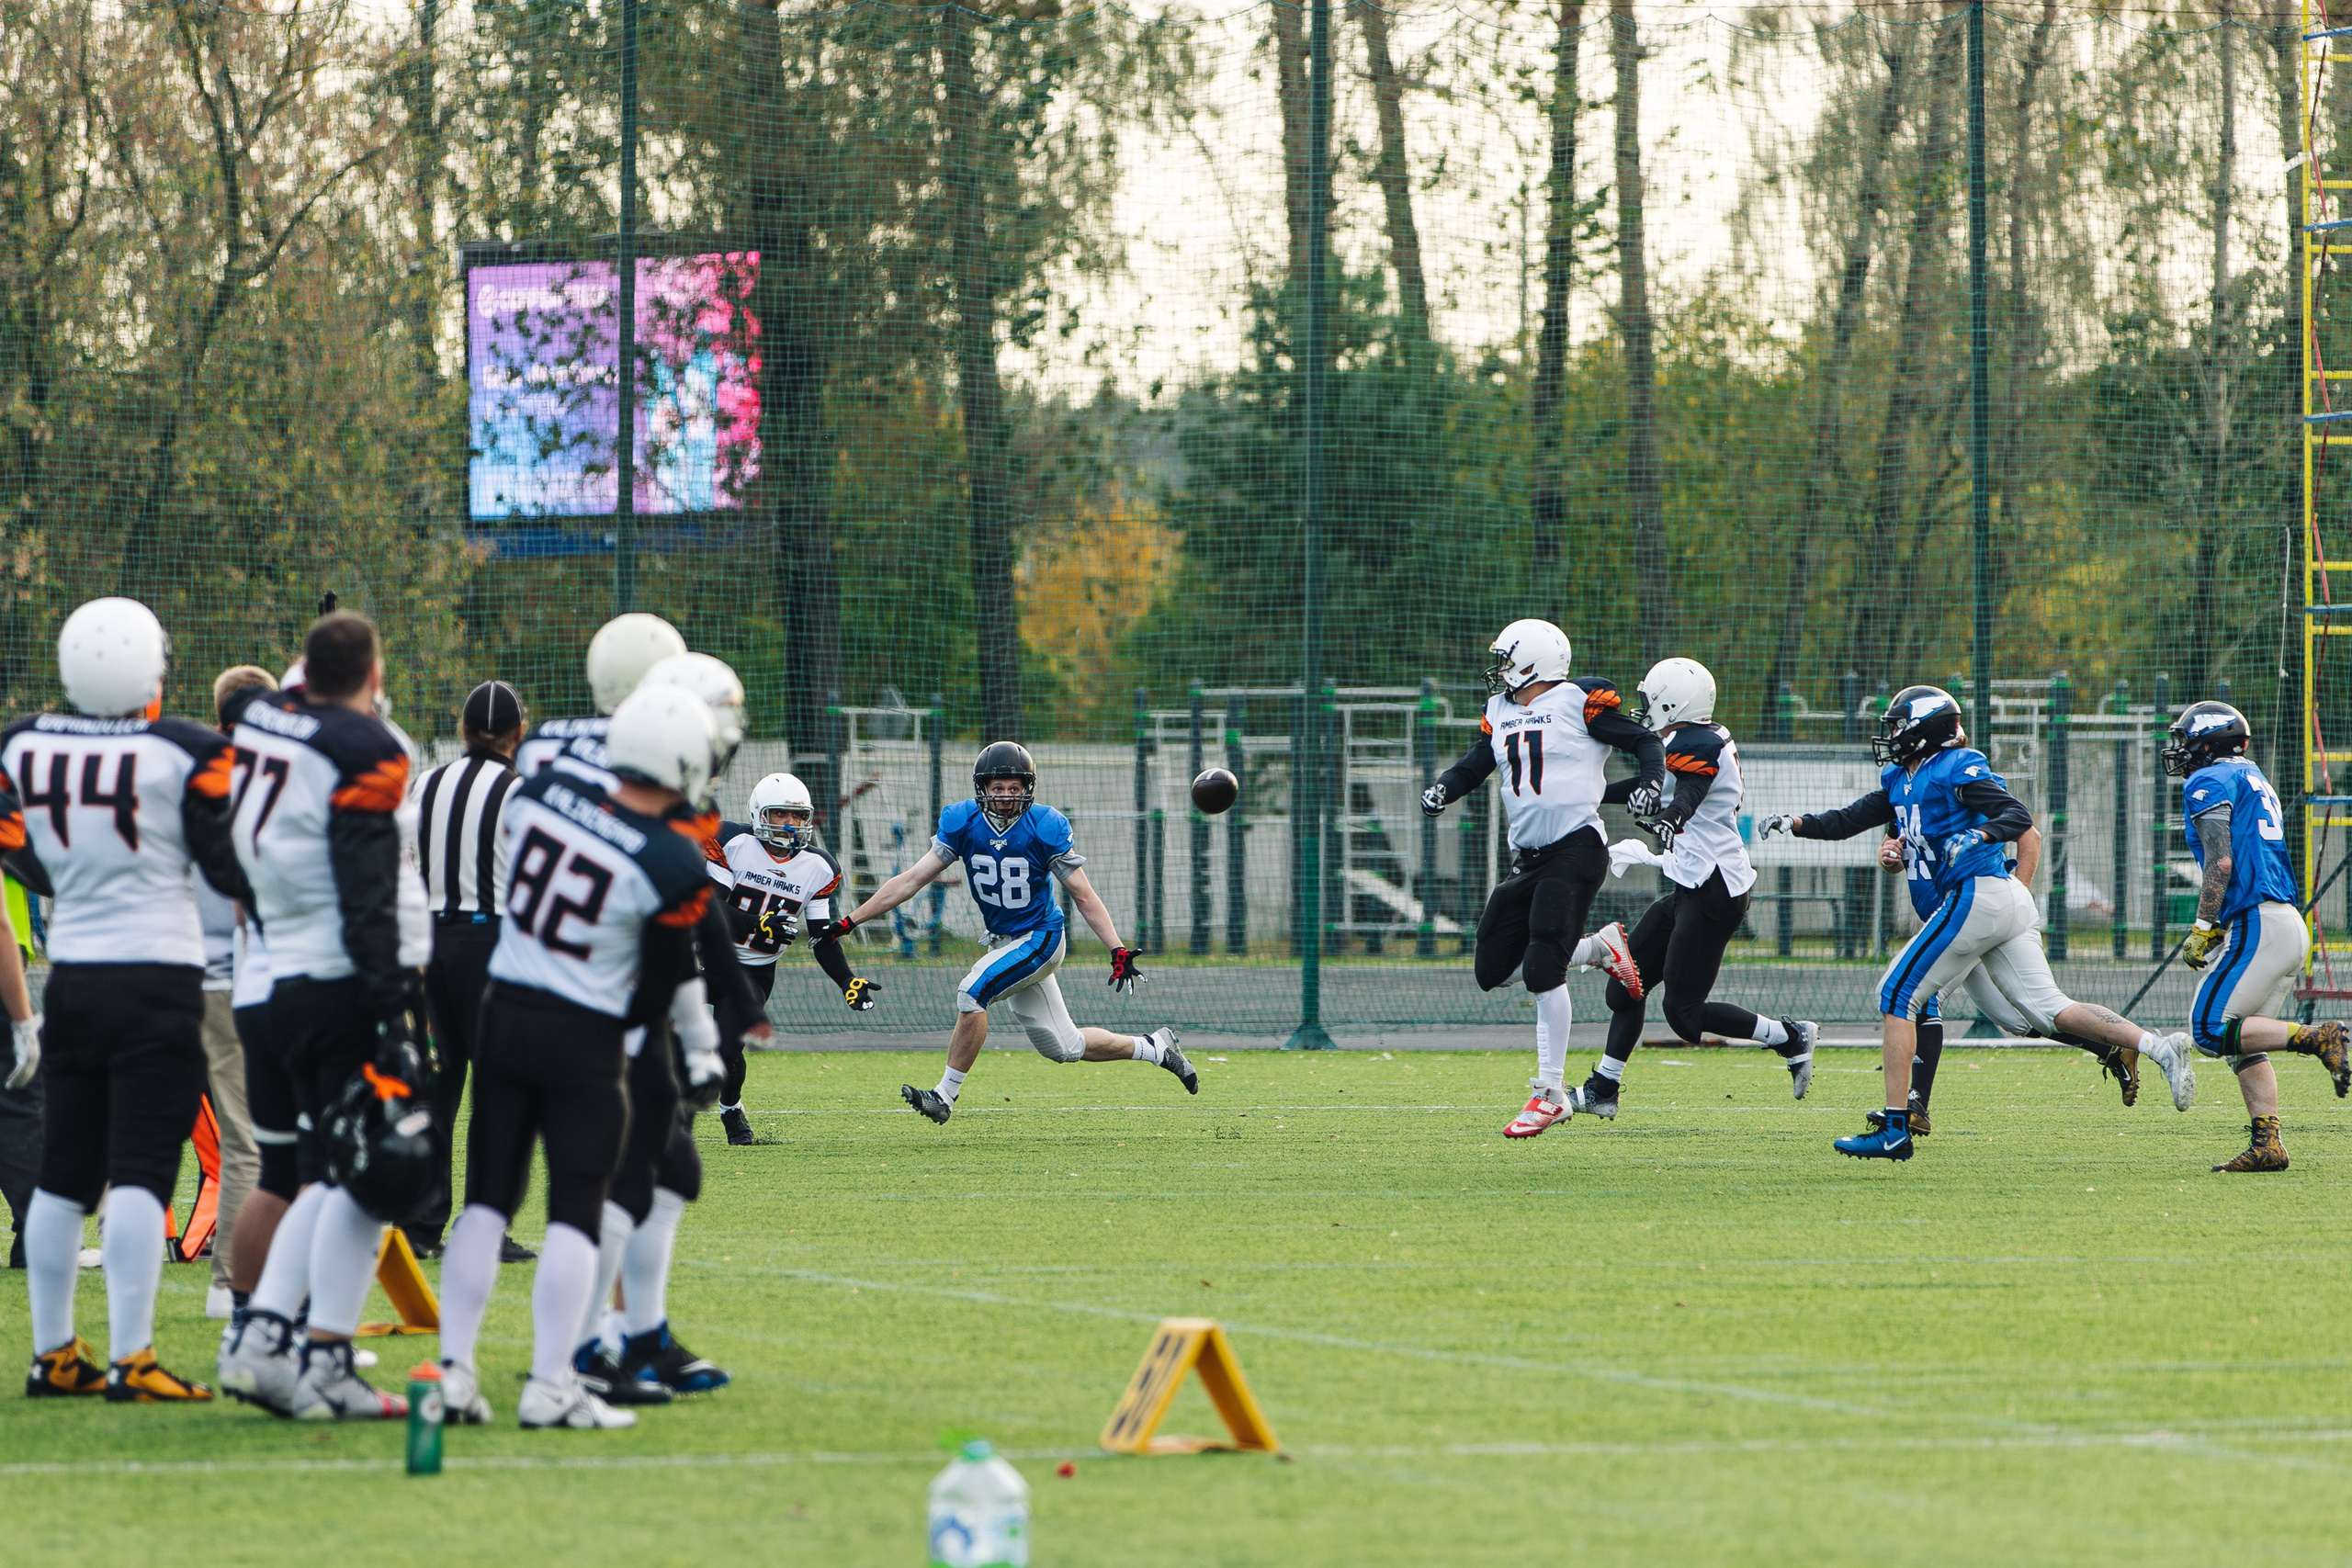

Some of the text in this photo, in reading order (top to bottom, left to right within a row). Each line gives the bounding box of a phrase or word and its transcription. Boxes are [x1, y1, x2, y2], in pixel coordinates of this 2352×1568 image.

[1500, 715, 1551, 730] AMBER HAWKS
[1504, 729, 1543, 797] 11
[20, 750, 139, 852] 44
[507, 823, 613, 961] 82
[745, 871, 801, 895] AMBER HAWKS
[971, 853, 1031, 909] 28
[1537, 1100, 1558, 1114] NIKE
